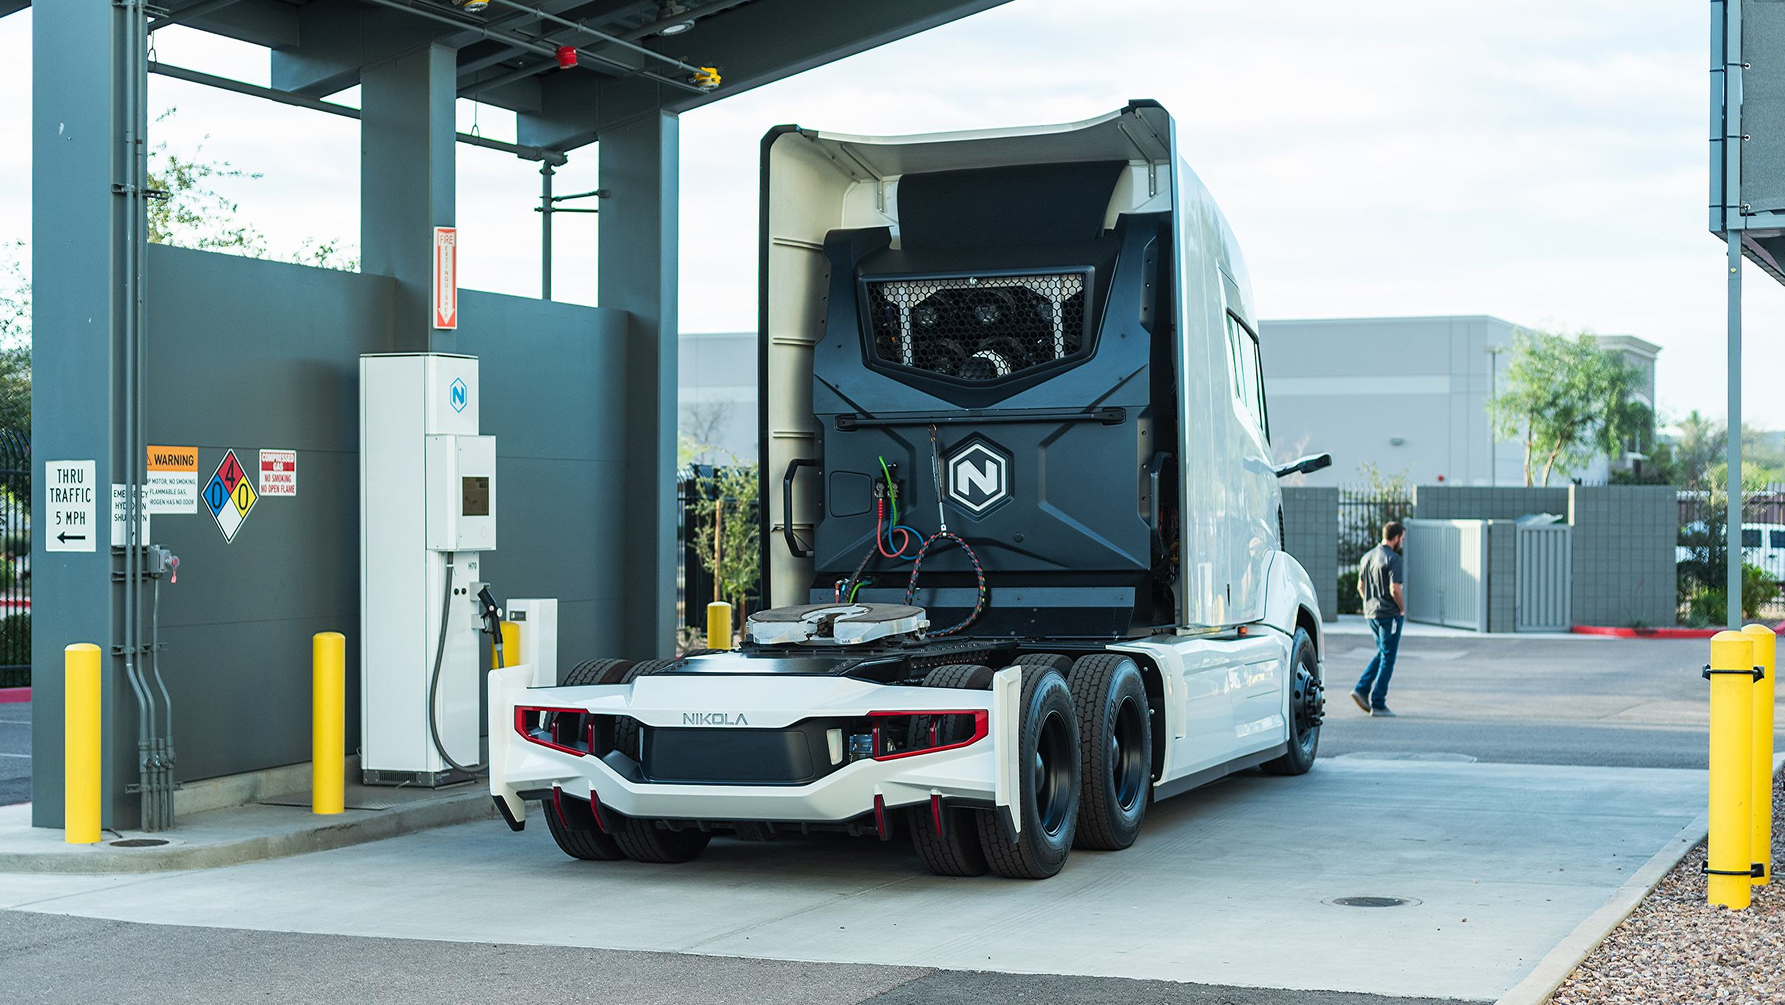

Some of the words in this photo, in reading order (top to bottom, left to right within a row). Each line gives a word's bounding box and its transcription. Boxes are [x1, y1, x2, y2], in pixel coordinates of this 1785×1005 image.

[440, 234, 453, 245] FIRE
[452, 385, 465, 405] N
[153, 454, 194, 466] WARNING
[273, 462, 284, 471] GAS
[57, 468, 84, 483] THRU
[225, 459, 236, 488] 4
[264, 474, 271, 482] NO
[272, 474, 292, 482] SMOKING
[957, 459, 998, 496] N
[50, 488, 91, 503] TRAFFIC
[211, 481, 223, 509] 0
[261, 484, 267, 493] NO
[268, 484, 279, 493] OPEN
[281, 485, 295, 493] FLAME
[238, 482, 249, 510] 0
[56, 511, 62, 525] 5
[65, 511, 86, 525] MPH
[683, 712, 749, 726] NIKOLA
